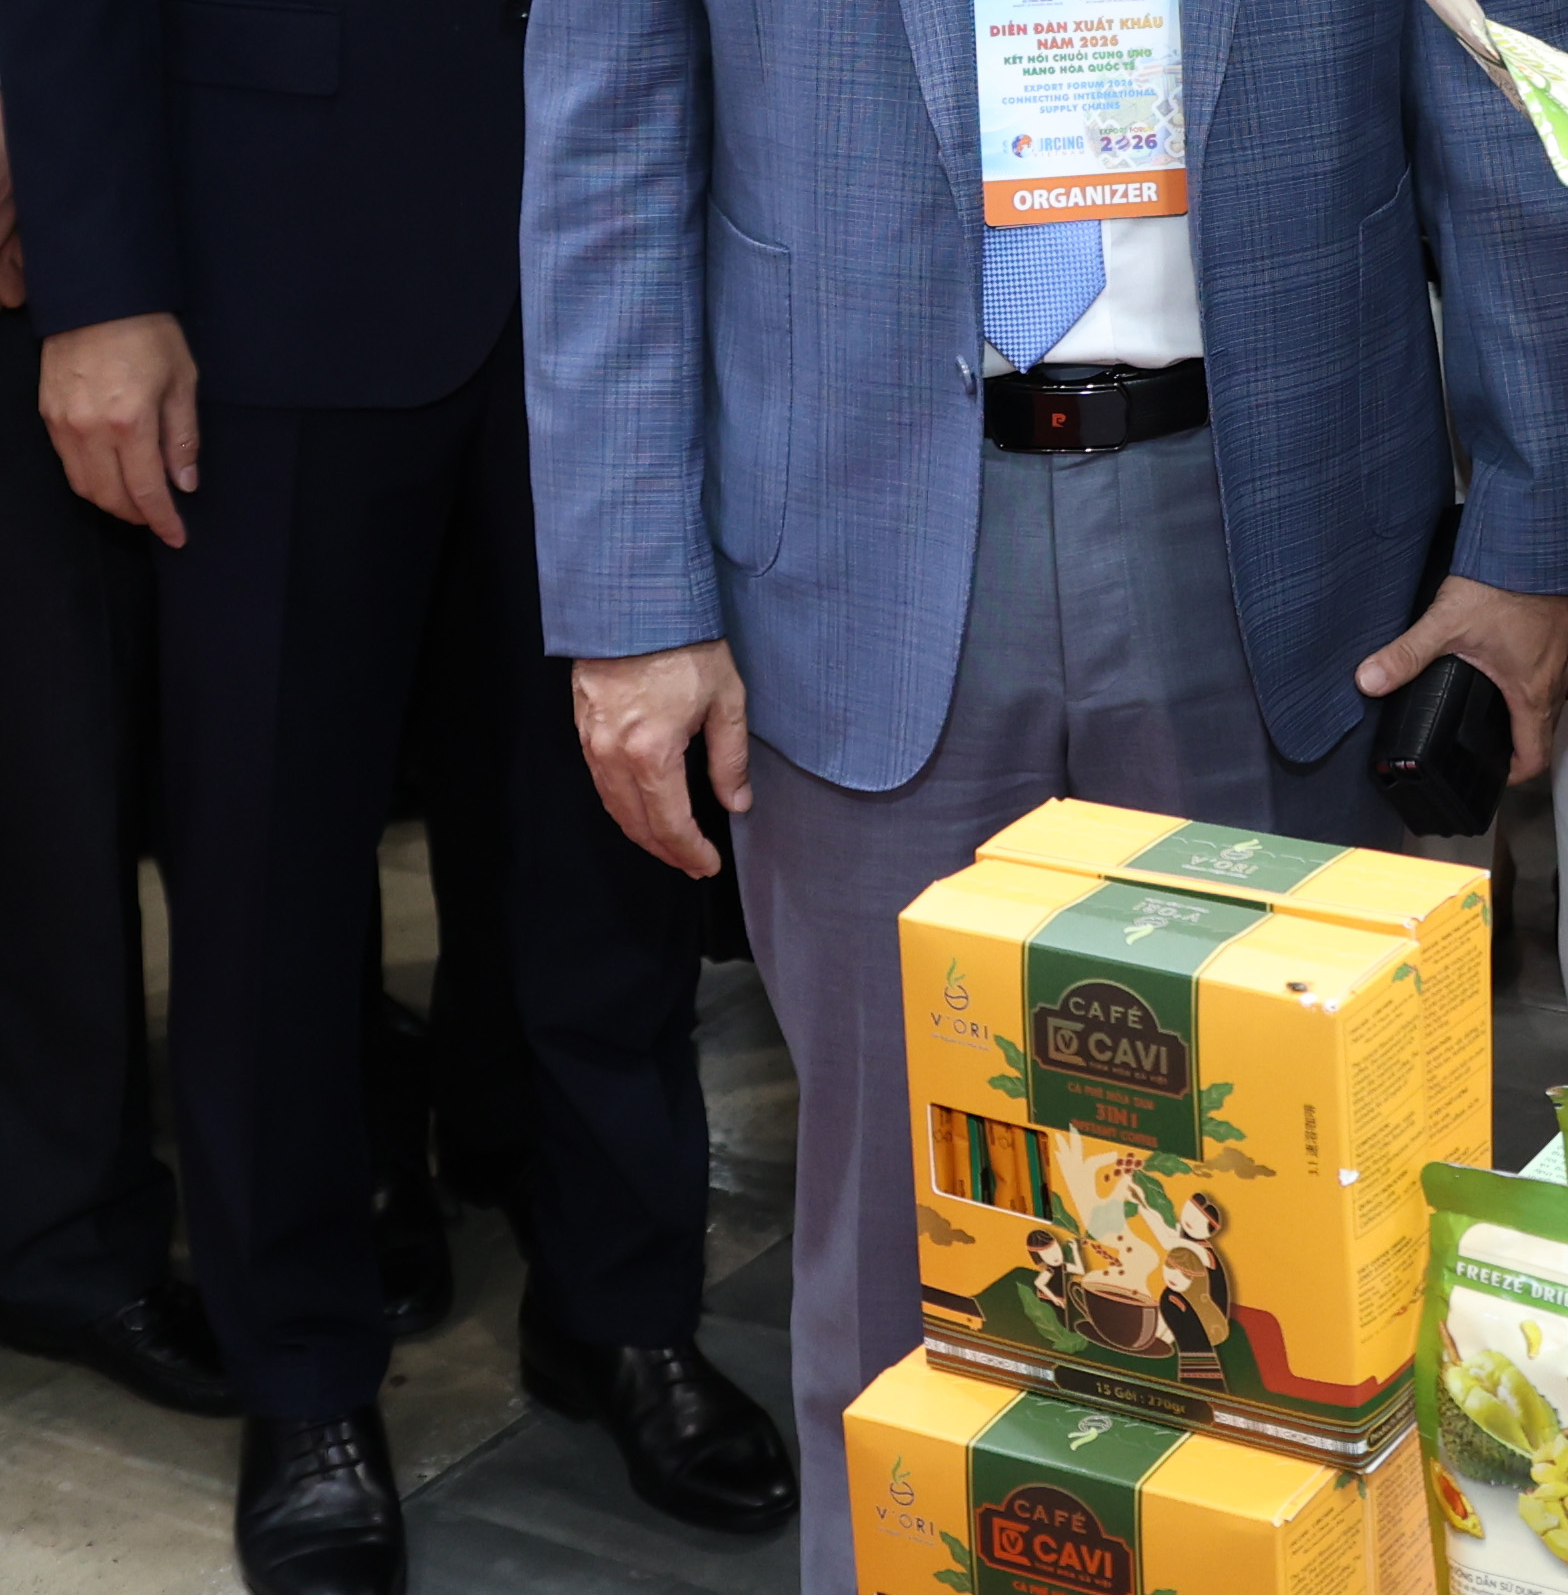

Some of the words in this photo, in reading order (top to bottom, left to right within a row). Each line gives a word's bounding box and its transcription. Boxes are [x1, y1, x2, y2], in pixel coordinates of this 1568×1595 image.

[1080, 34, 1119, 48] 2026
[1092, 49, 1124, 61] CUNG
[1002, 93, 1070, 105] CONNECTING
[1073, 88, 1157, 101] INTERNATIONAL
[1024, 83, 1064, 93] EXPORT
[1067, 81, 1105, 91] FORUM
[1108, 79, 1134, 89] 2026
[1039, 103, 1078, 114] SUPPLY
[1082, 101, 1121, 112] CHAINS
[1013, 182, 1159, 211] ORGANIZER
[1068, 996, 1143, 1030] CAFÉ
[1088, 1032, 1169, 1075] CAVI
[1455, 1260, 1526, 1294] FREEZE
[1096, 1381, 1112, 1396] 15
[1013, 1499, 1088, 1534] CAFÉ
[1032, 1533, 1113, 1579] CAVI
